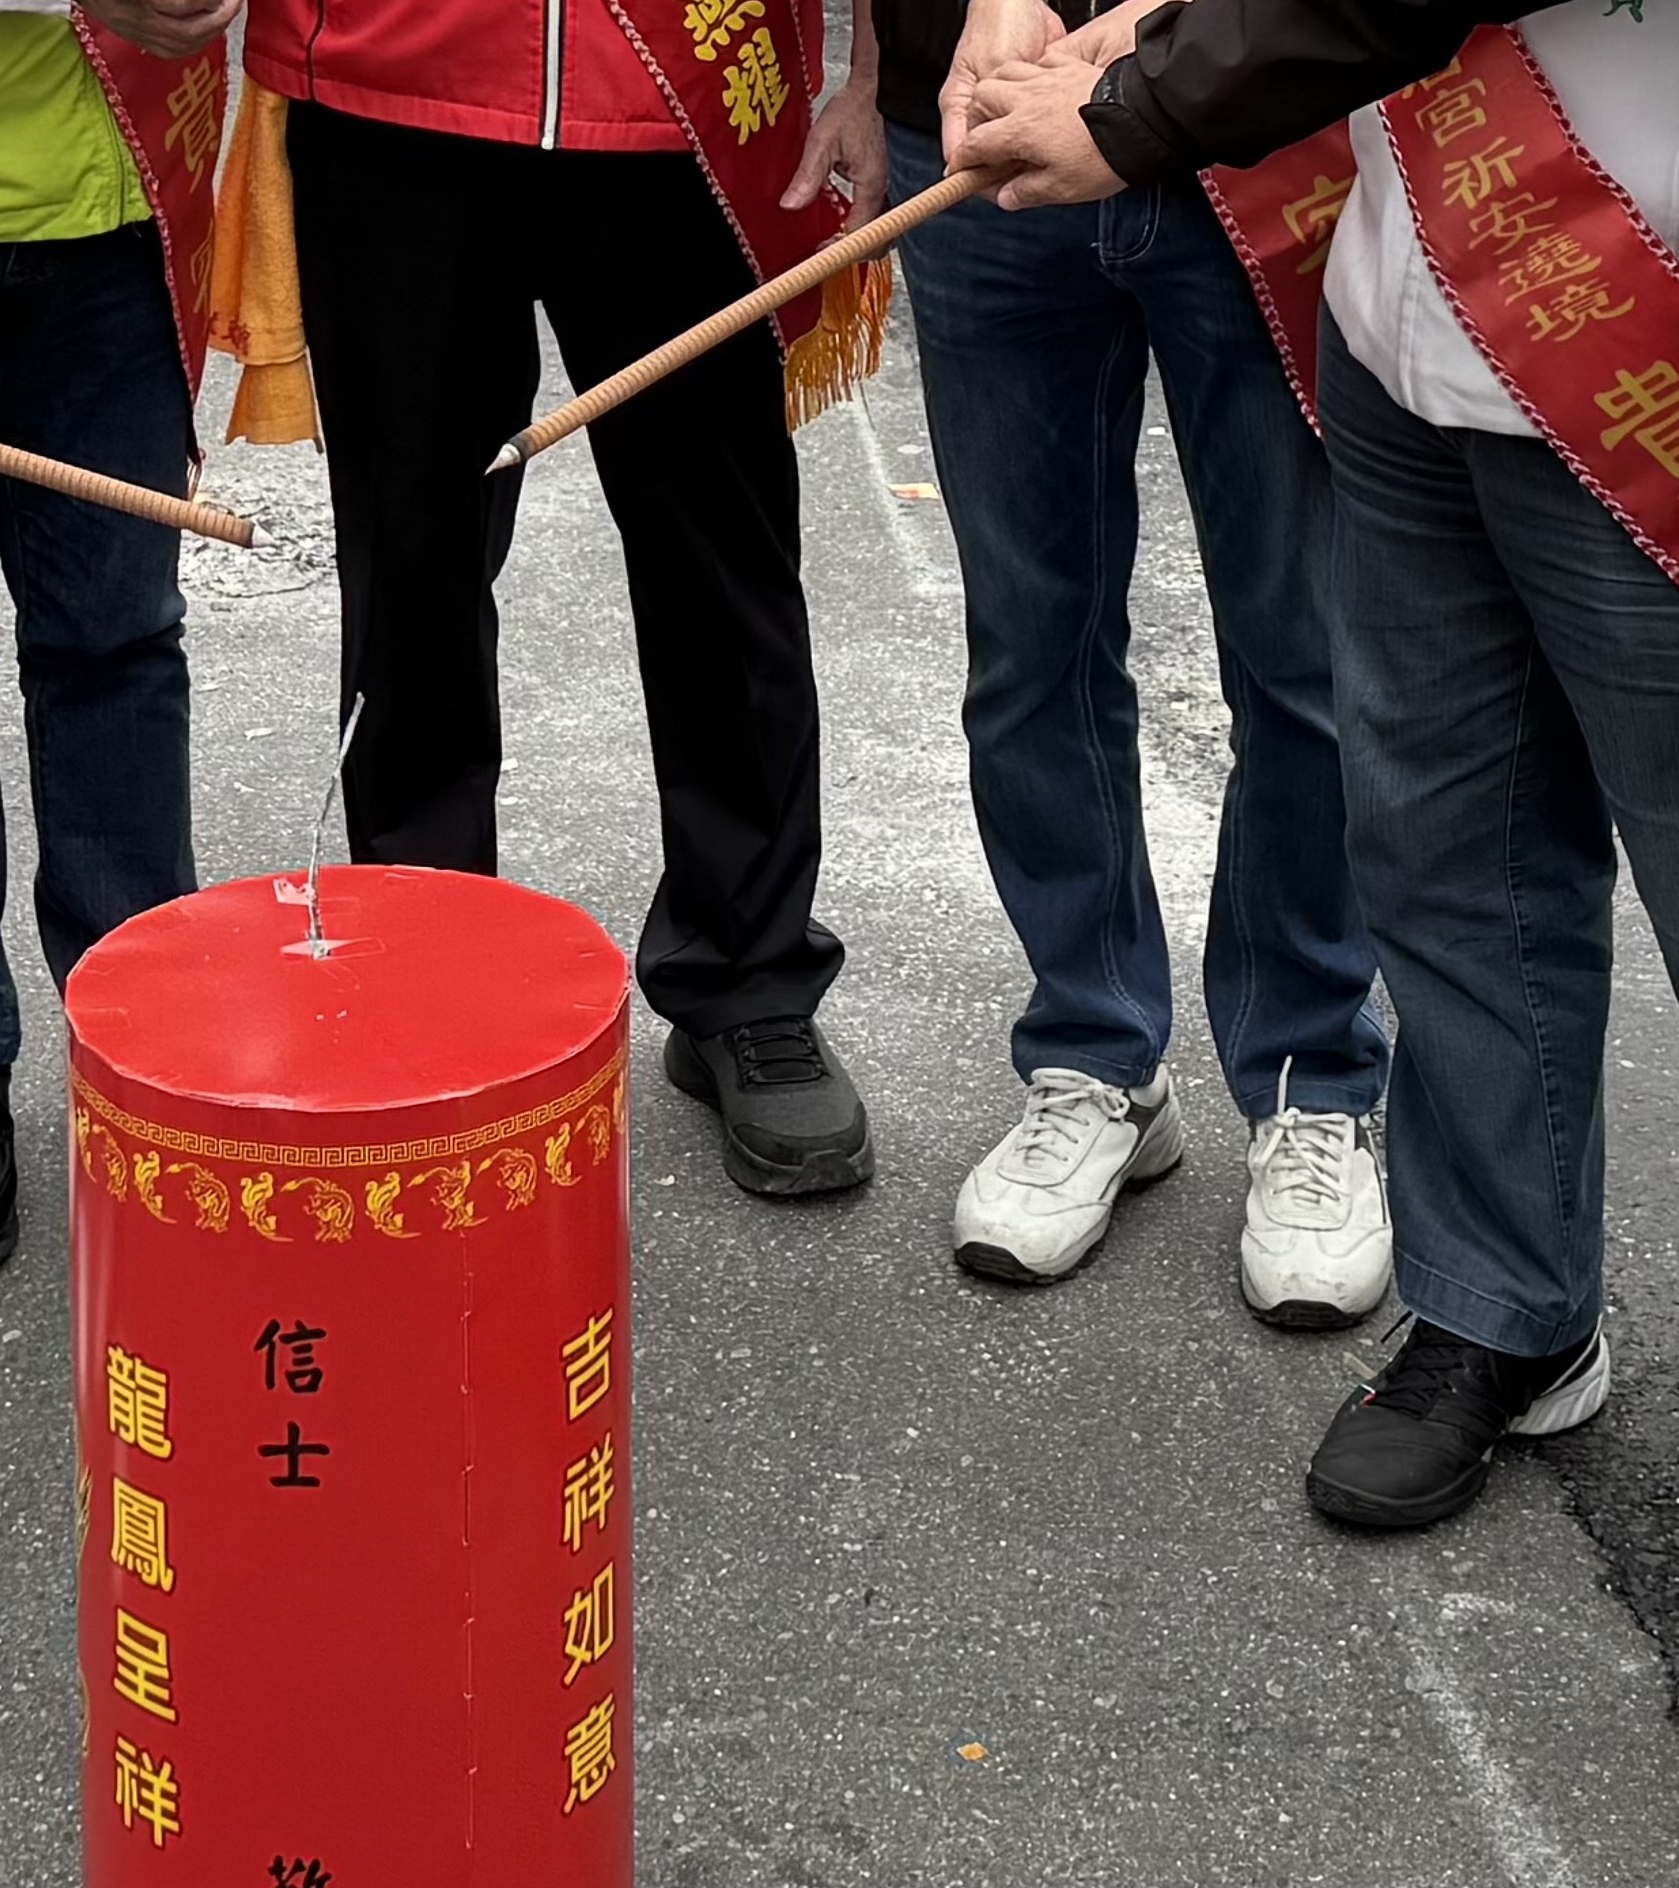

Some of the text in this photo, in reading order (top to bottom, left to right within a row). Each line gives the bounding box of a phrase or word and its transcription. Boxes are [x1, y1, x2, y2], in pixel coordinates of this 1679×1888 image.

[106, 1345, 184, 1851] 龍鳳呈祥
[254, 1317, 331, 1490] 信士
[560, 1306, 618, 1818] 吉祥如意
